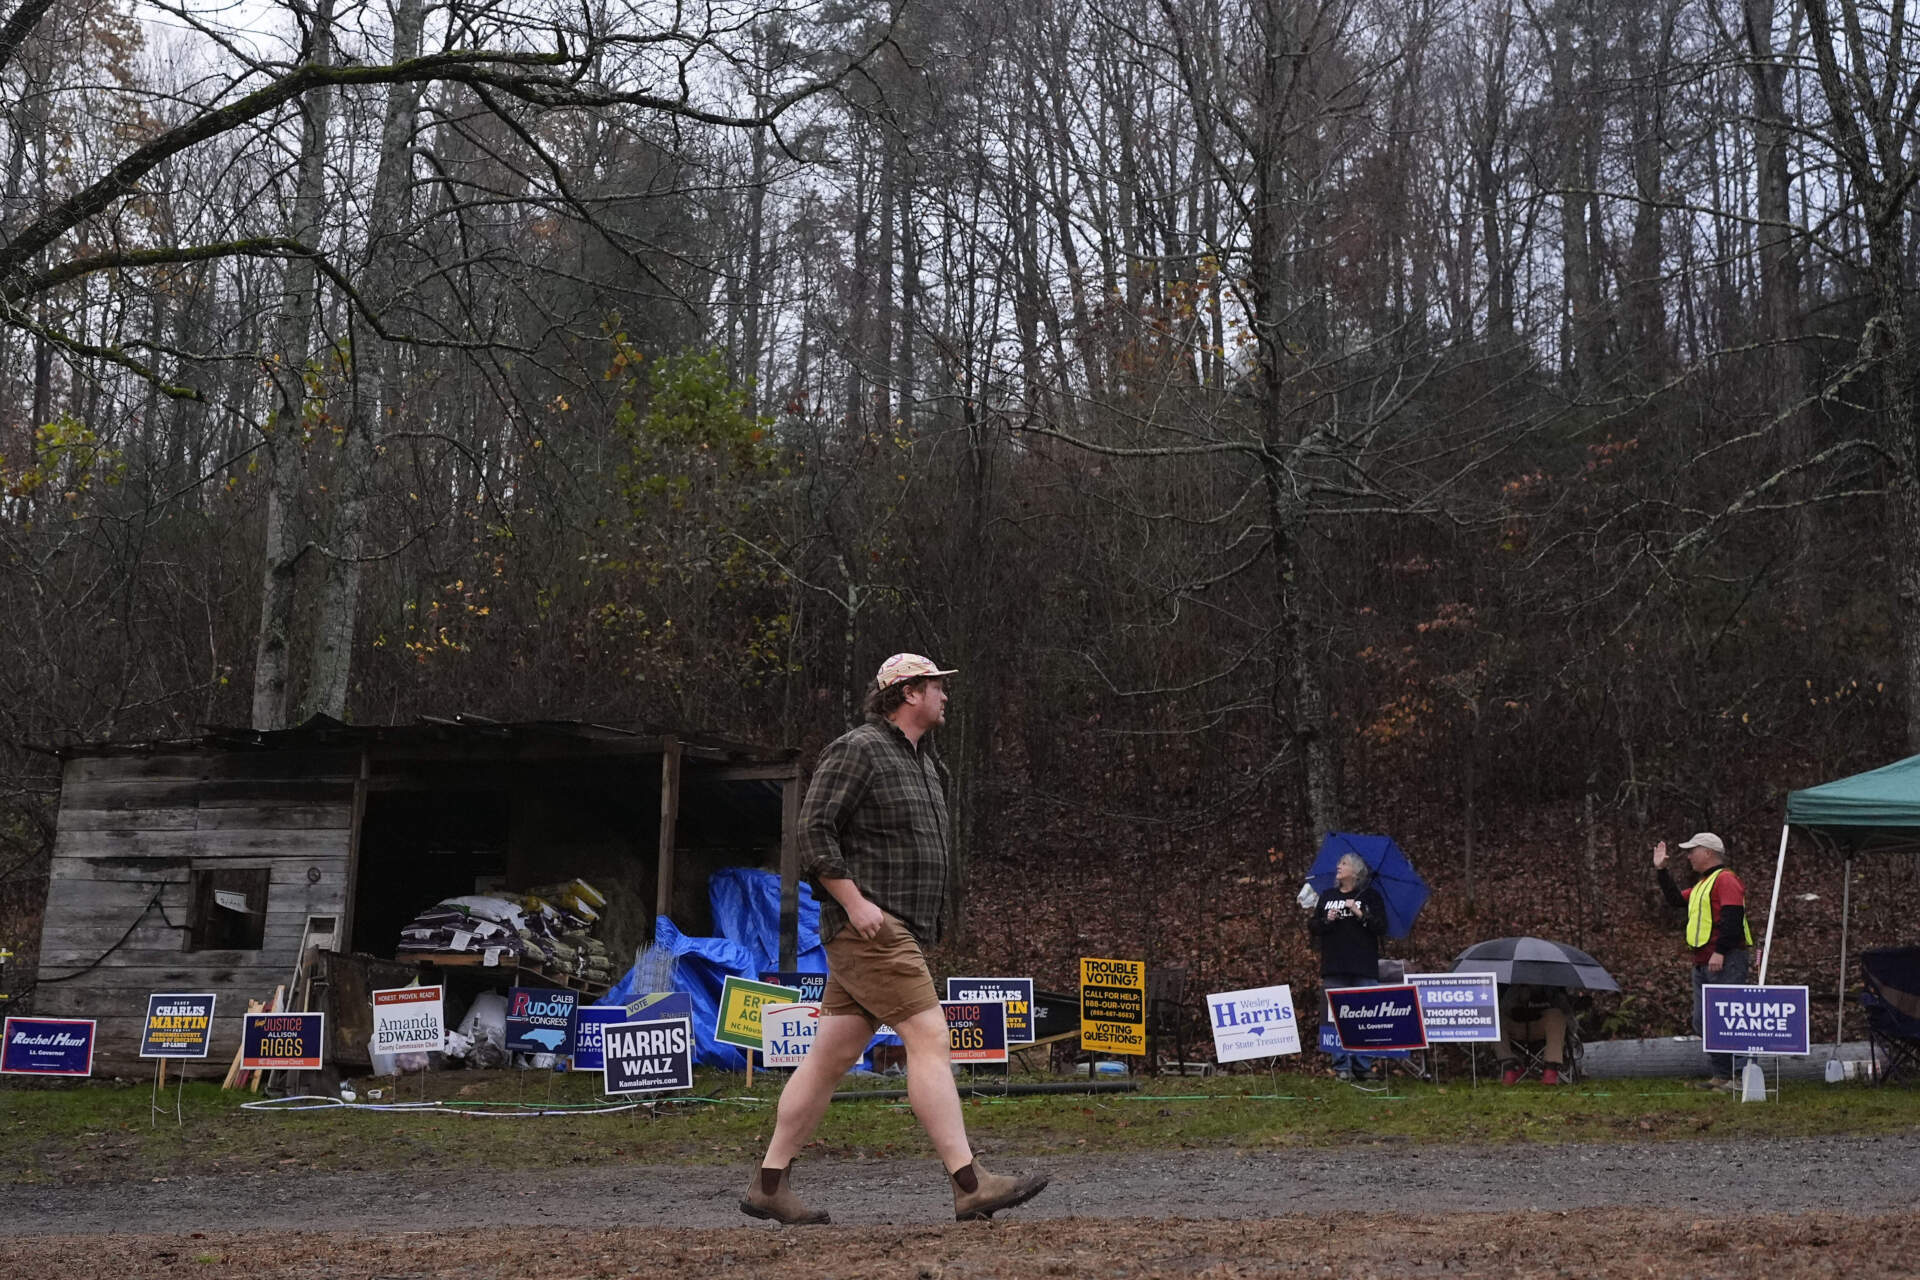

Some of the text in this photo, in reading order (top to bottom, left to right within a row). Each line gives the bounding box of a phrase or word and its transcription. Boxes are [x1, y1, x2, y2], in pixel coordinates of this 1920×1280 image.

[1325, 900, 1361, 910] HARS
[1084, 961, 1138, 975] TROUBLE
[801, 976, 823, 985] CALEB
[1086, 973, 1138, 986] VOTING?
[551, 994, 574, 1004] CALEB
[958, 990, 1023, 1001] CHARLES
[1104, 992, 1119, 1000] FOR
[1427, 990, 1474, 1003] RIGGS
[512, 992, 573, 1017] RUDOW
[628, 999, 649, 1012] VOTE
[1240, 998, 1270, 1009] Wesley
[1339, 1002, 1411, 1018] Rachel Hunt
[1715, 1002, 1796, 1018] TRUMP
[156, 1006, 205, 1016] CHARLES
[1212, 1002, 1292, 1028] Harris
[1426, 1009, 1478, 1017] THOMPSON
[148, 1016, 208, 1029] MARTIN
[379, 1012, 437, 1032] Amanda
[529, 1016, 568, 1026] CONGRESS
[1458, 1017, 1492, 1025] MOORE
[1723, 1018, 1787, 1031] VANCE
[1095, 1023, 1132, 1035] VOTING
[12, 1032, 86, 1047] Rachel Hunt
[378, 1028, 439, 1044] EDWARDS
[1084, 1031, 1142, 1045] QUESTIONS?
[1323, 1033, 1334, 1047] NC
[260, 1038, 303, 1057] RIGGS
[396, 1042, 424, 1050] Commission
[606, 1028, 686, 1059] HARRIS
[1223, 1035, 1294, 1054] for State Treasurer
[621, 1057, 673, 1077] WALZ
[619, 1077, 678, 1088] KamalaHarris.com
